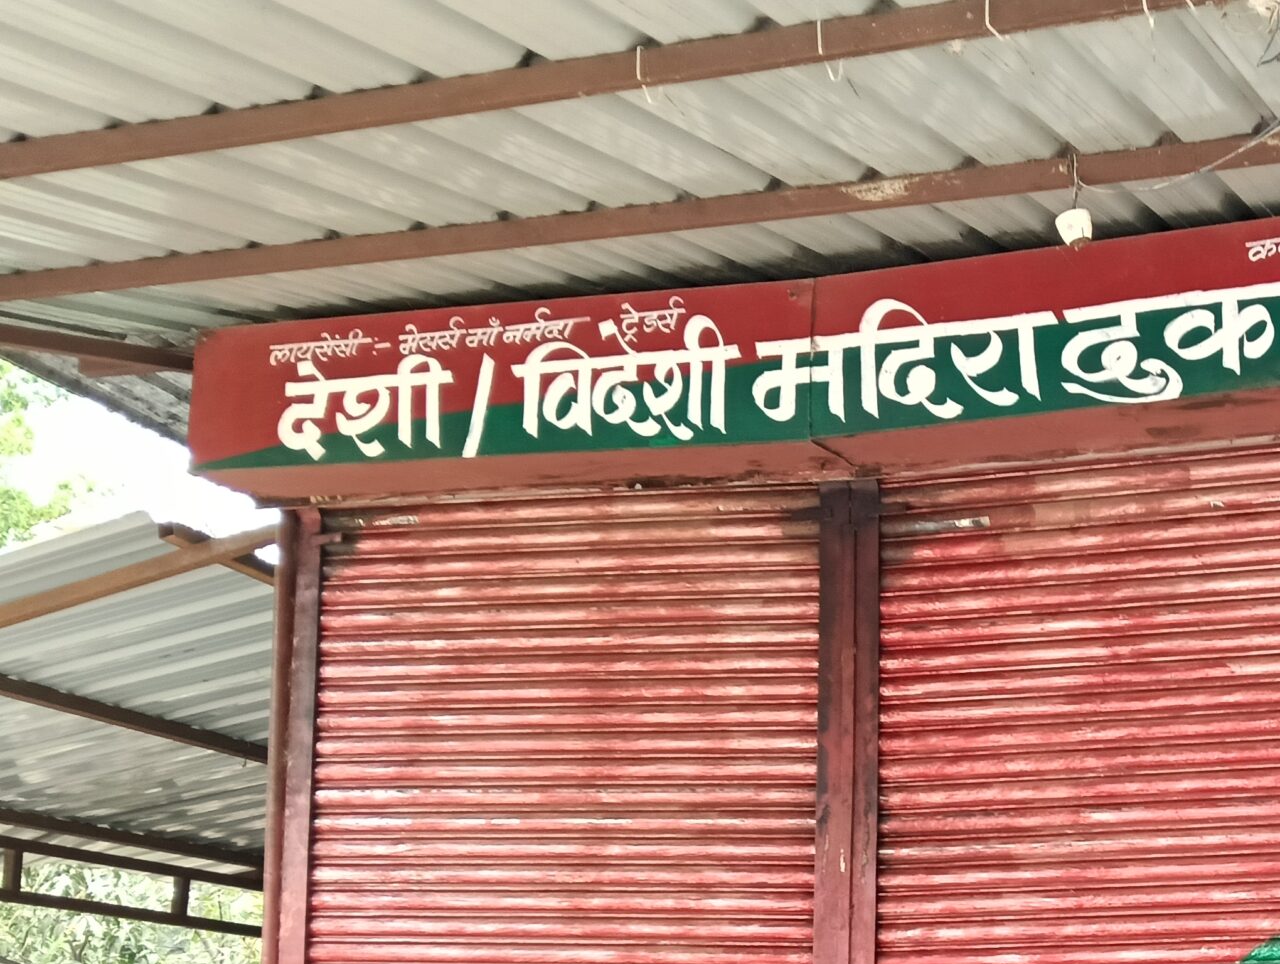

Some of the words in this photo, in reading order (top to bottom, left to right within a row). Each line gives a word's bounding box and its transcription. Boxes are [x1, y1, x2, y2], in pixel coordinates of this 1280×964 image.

[466, 316, 503, 349] माँ
[502, 306, 591, 345] नर्मदा
[619, 295, 688, 343] ट्रेडर्स
[276, 353, 454, 461] देशी
[511, 314, 742, 441] विदेशी
[751, 298, 1060, 424] मदिरा
